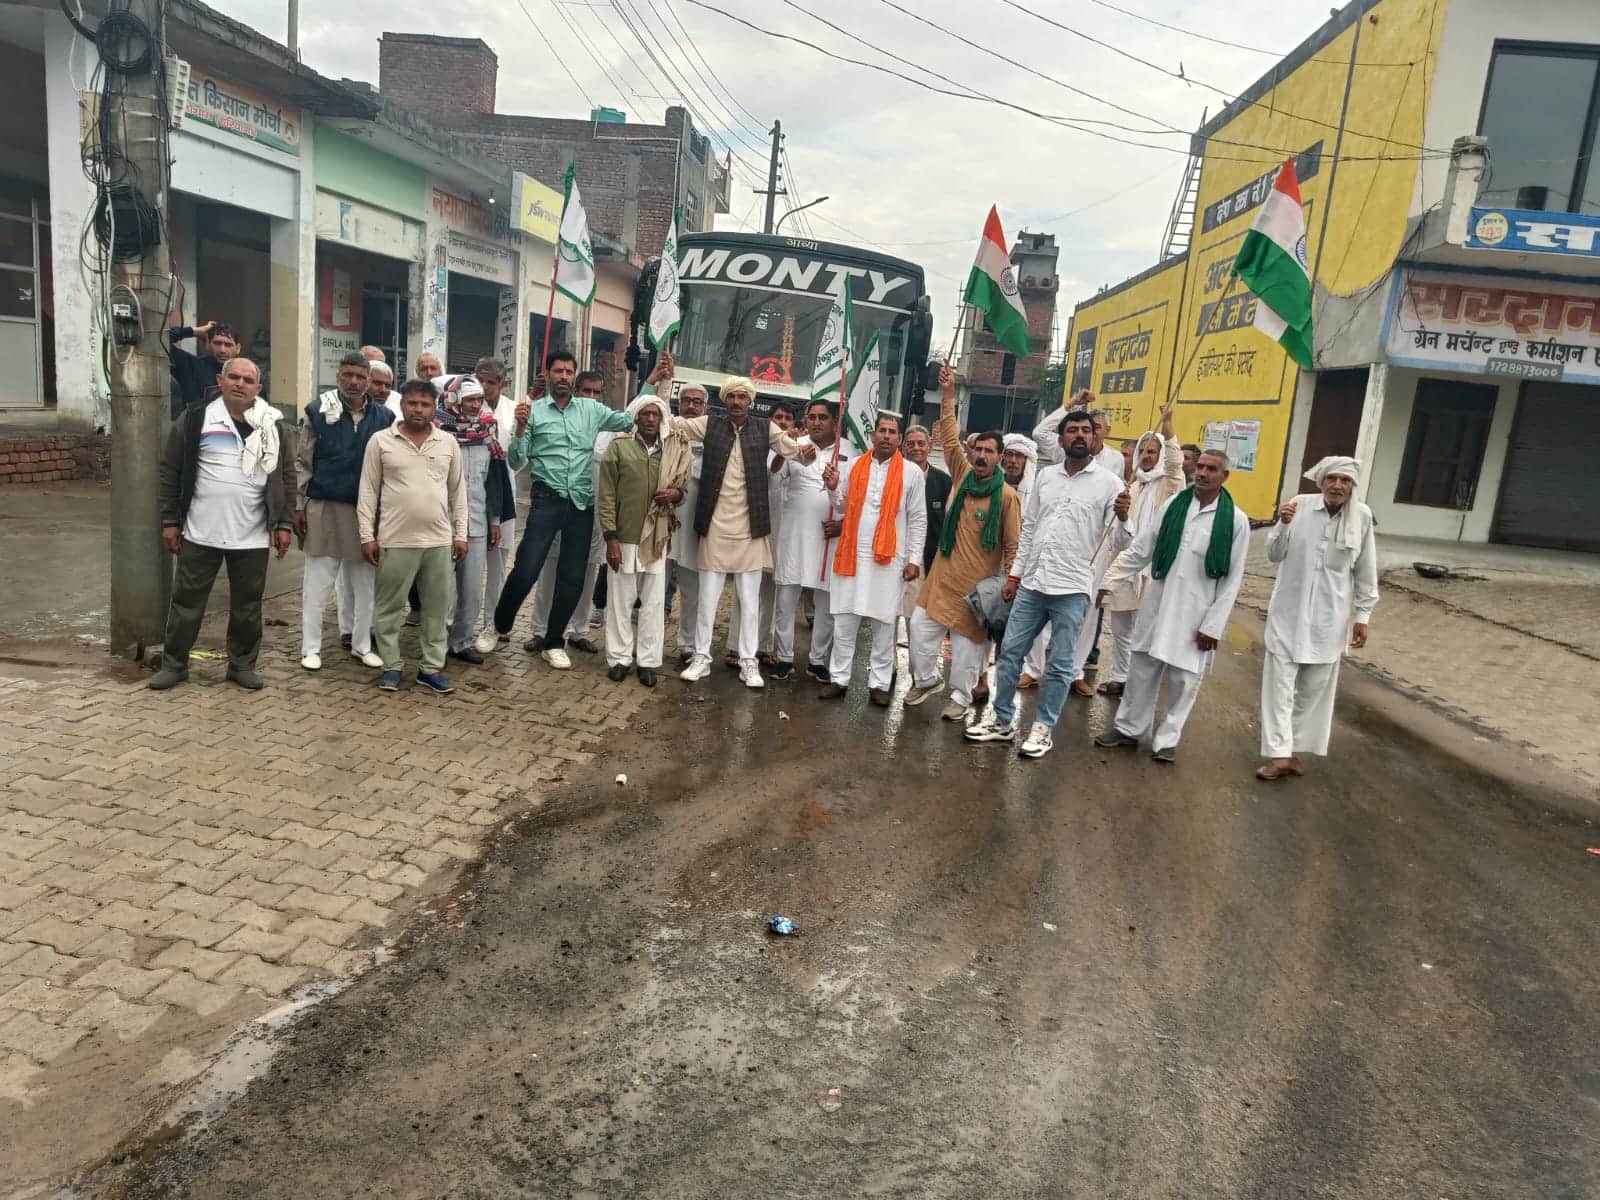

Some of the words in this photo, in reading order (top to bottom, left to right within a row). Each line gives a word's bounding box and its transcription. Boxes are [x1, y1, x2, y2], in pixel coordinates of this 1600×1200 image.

[204, 80, 250, 121] किसान
[1514, 220, 1600, 250] स
[679, 248, 911, 303] MONTY
[322, 337, 343, 349] BIRLA
[1526, 336, 1588, 365] कमीशन
